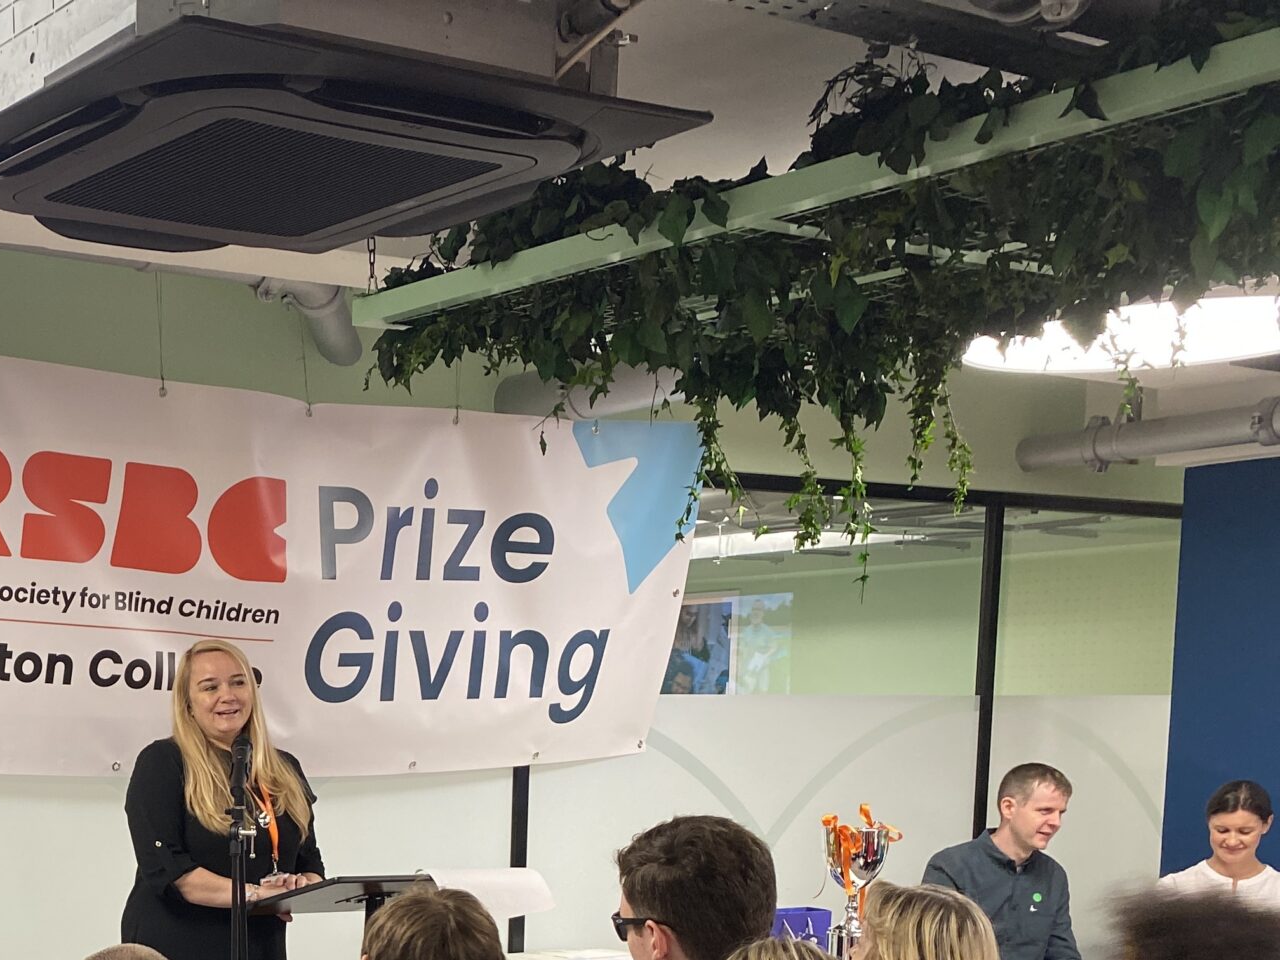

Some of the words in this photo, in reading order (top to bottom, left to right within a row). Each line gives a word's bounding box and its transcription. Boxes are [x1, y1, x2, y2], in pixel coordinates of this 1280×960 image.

[318, 477, 555, 584] Prize
[77, 586, 111, 610] for
[114, 590, 175, 616] Blind
[178, 597, 281, 626] Children
[88, 649, 263, 693] Coll
[304, 601, 611, 724] Giving
